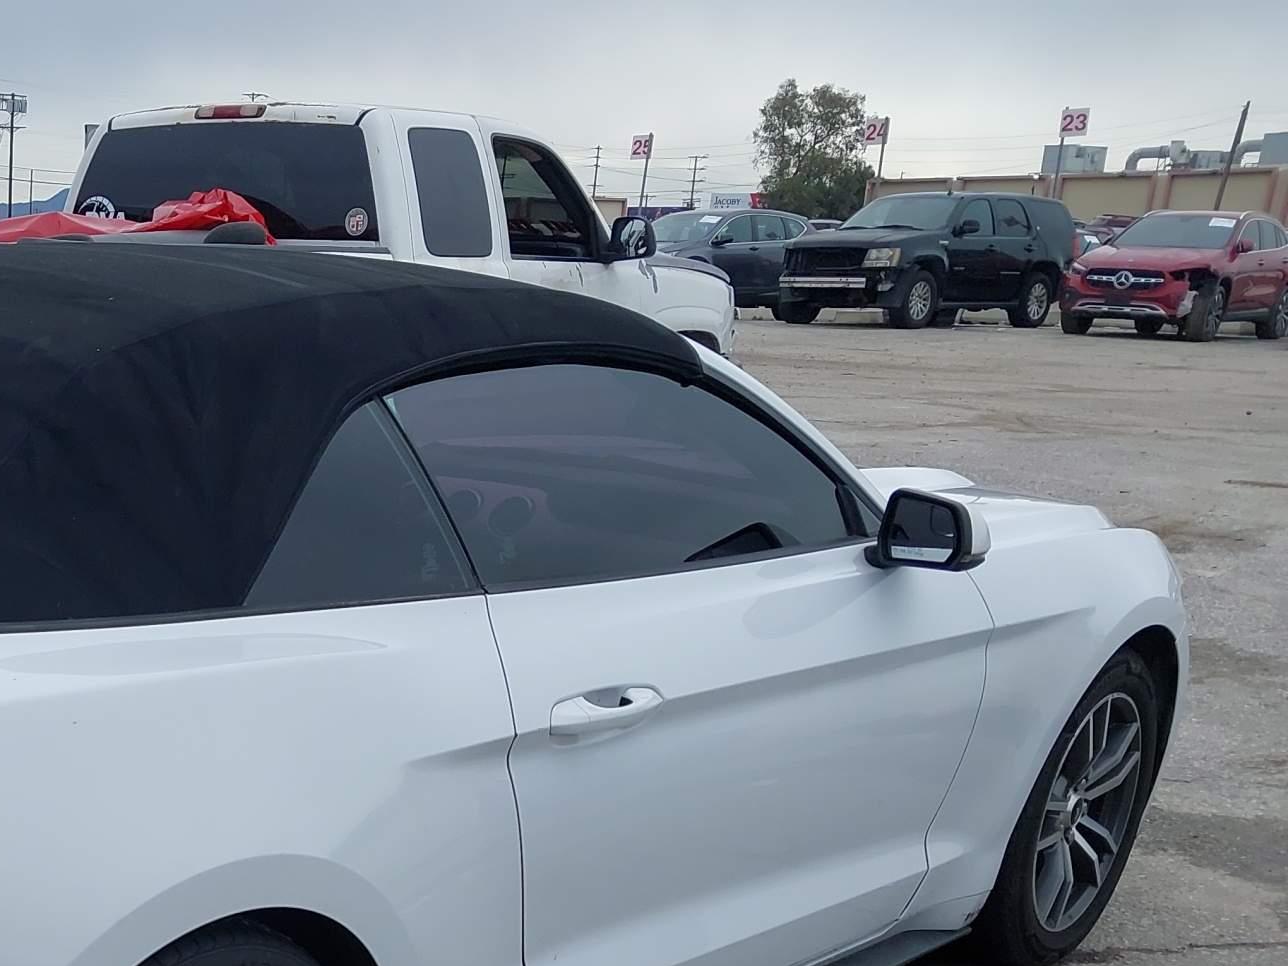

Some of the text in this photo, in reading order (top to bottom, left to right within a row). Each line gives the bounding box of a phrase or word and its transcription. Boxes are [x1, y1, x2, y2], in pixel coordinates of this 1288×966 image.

[865, 122, 885, 141] 24
[1062, 113, 1087, 132] 23
[631, 138, 649, 155] 25
